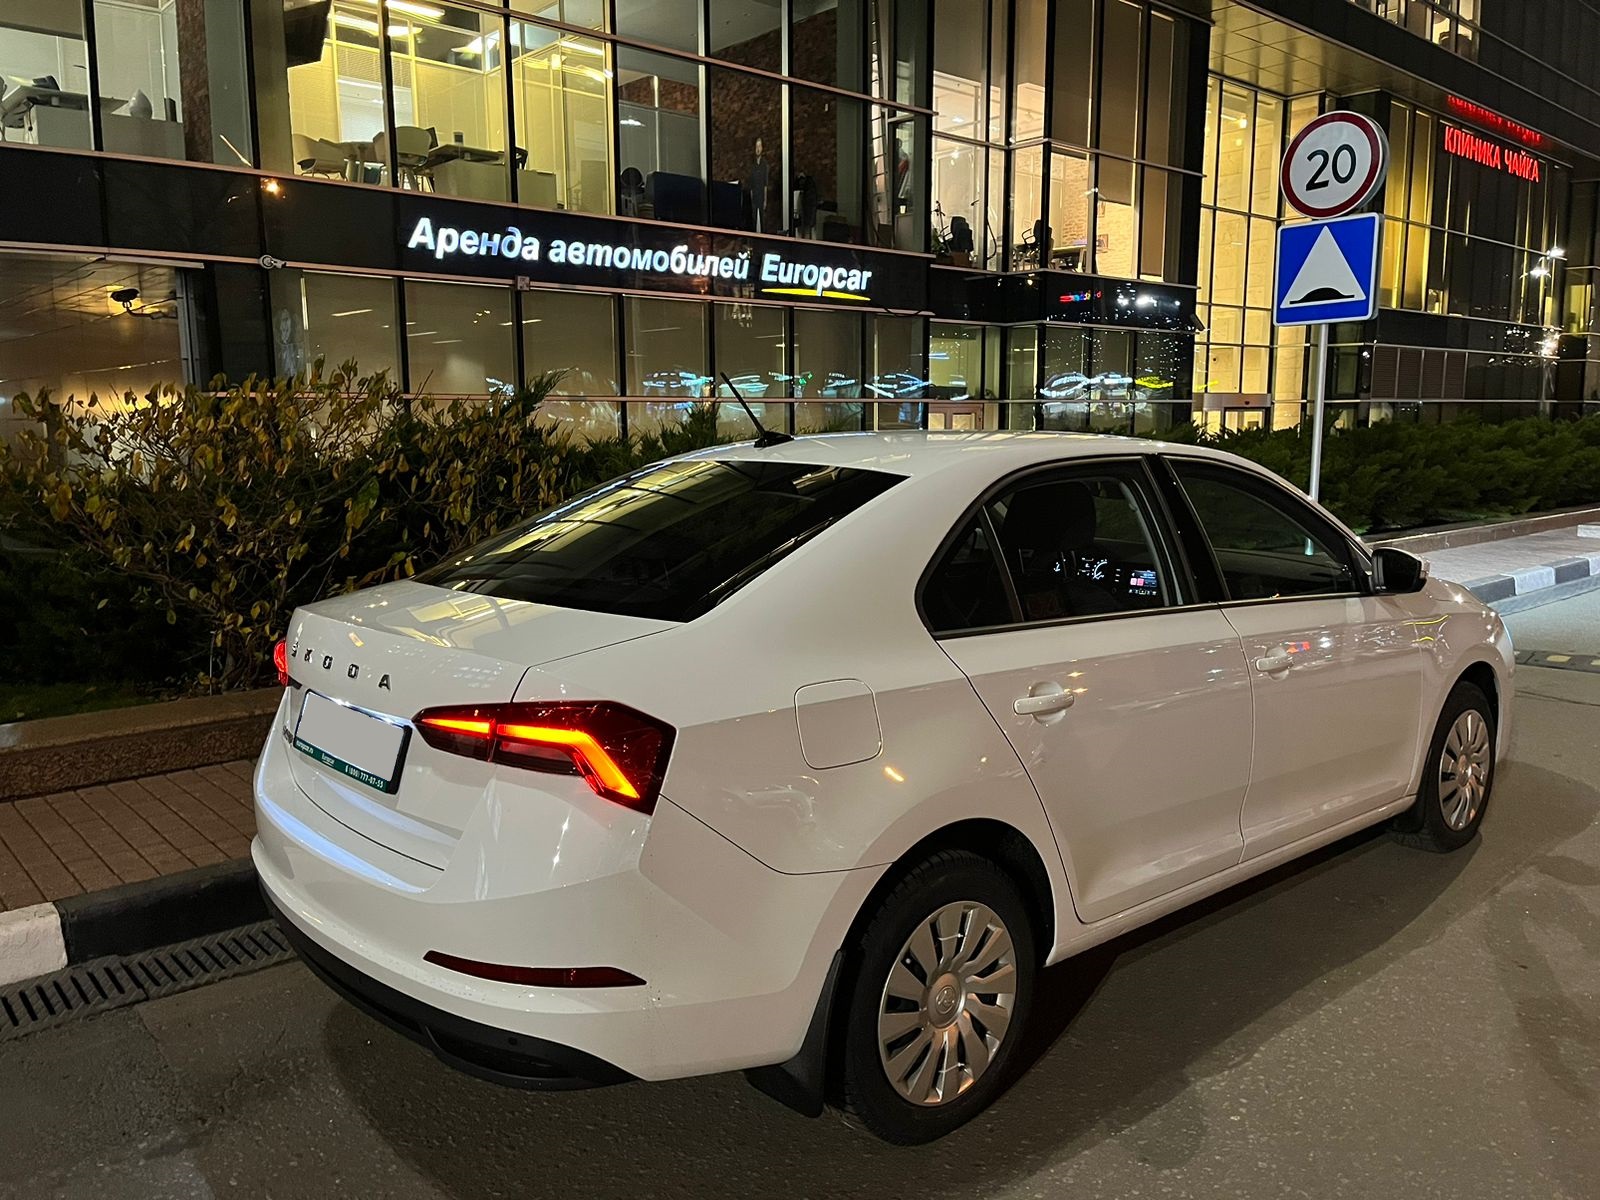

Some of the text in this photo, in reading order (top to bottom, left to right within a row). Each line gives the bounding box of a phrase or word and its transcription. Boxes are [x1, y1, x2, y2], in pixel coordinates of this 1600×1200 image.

[1305, 143, 1357, 192] 20
[1444, 125, 1501, 170] КЛИНИКА
[1504, 148, 1540, 183] ЧАЙКА
[408, 216, 873, 298] Аренда автомобилей Europcar
